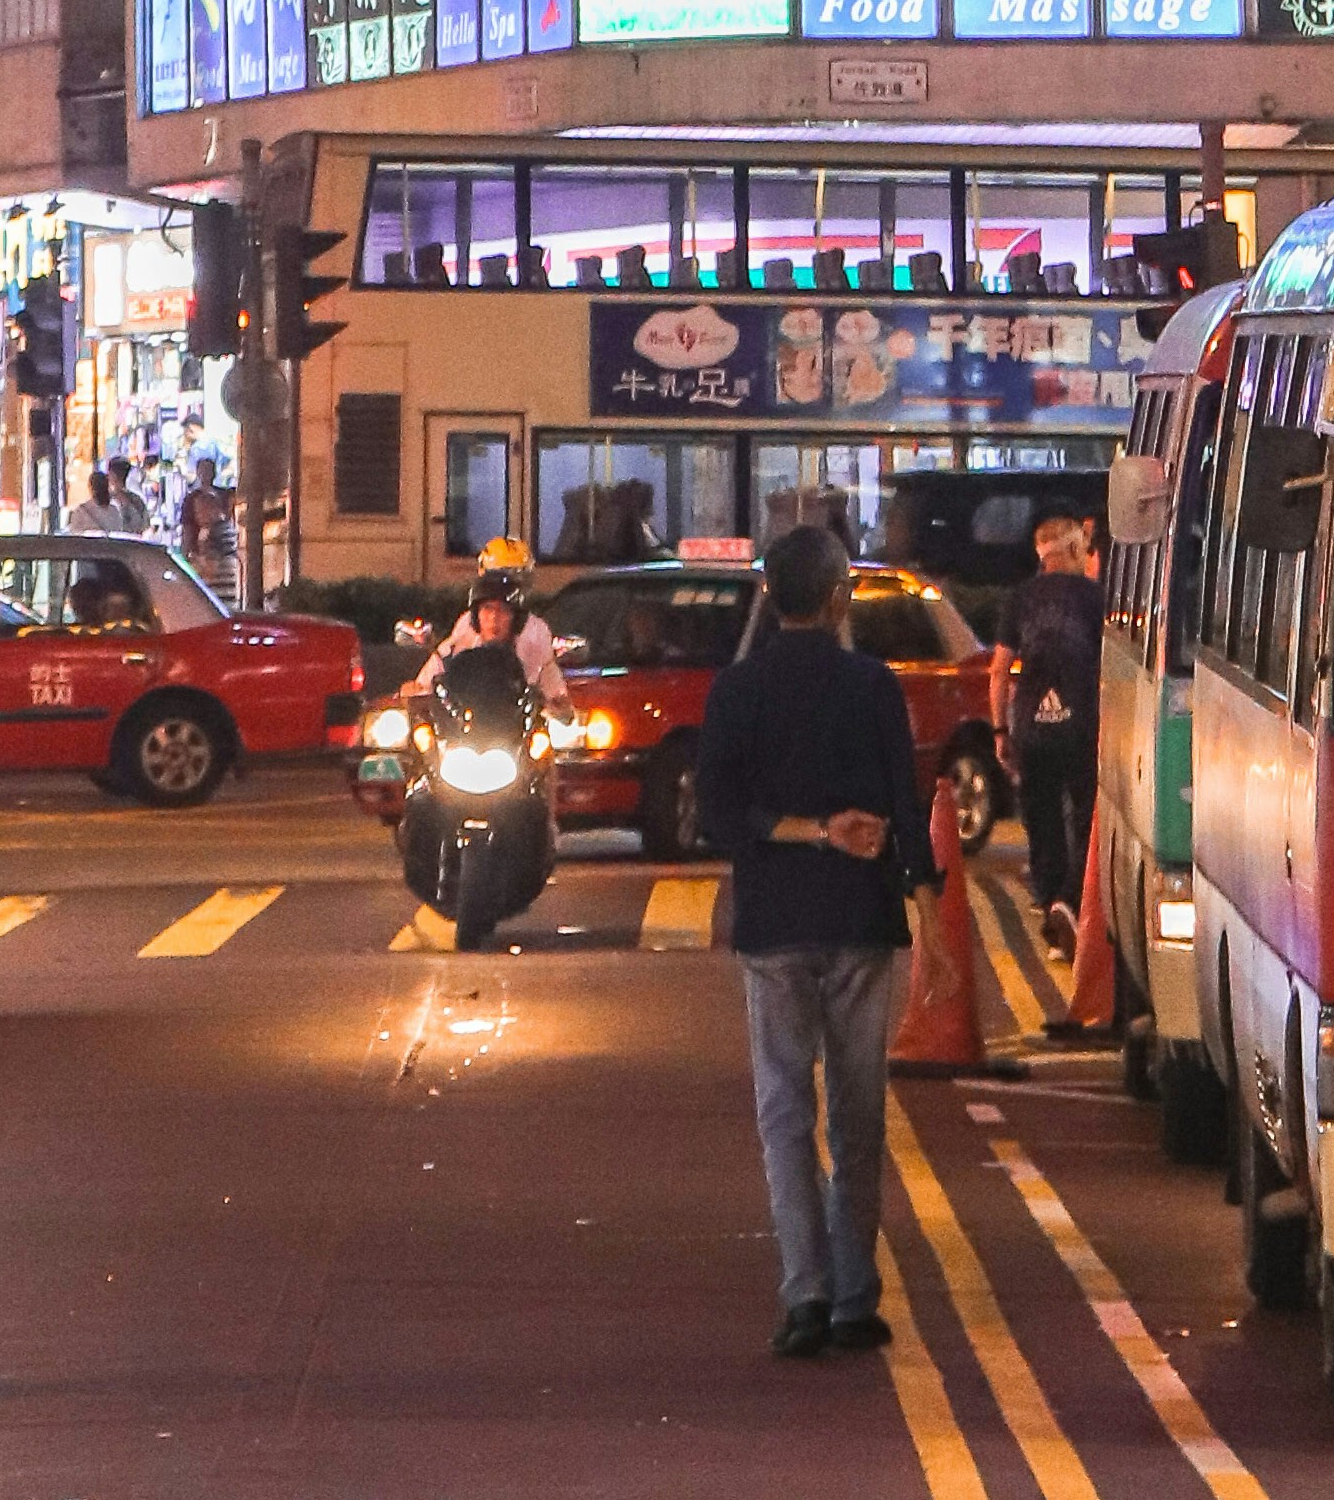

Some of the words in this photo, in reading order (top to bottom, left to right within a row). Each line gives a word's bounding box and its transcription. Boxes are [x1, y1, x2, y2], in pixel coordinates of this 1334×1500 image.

[442, 10, 476, 48] Hello
[488, 6, 515, 46] Spa
[30, 664, 72, 682] 的士
[30, 685, 72, 705] TAXI
